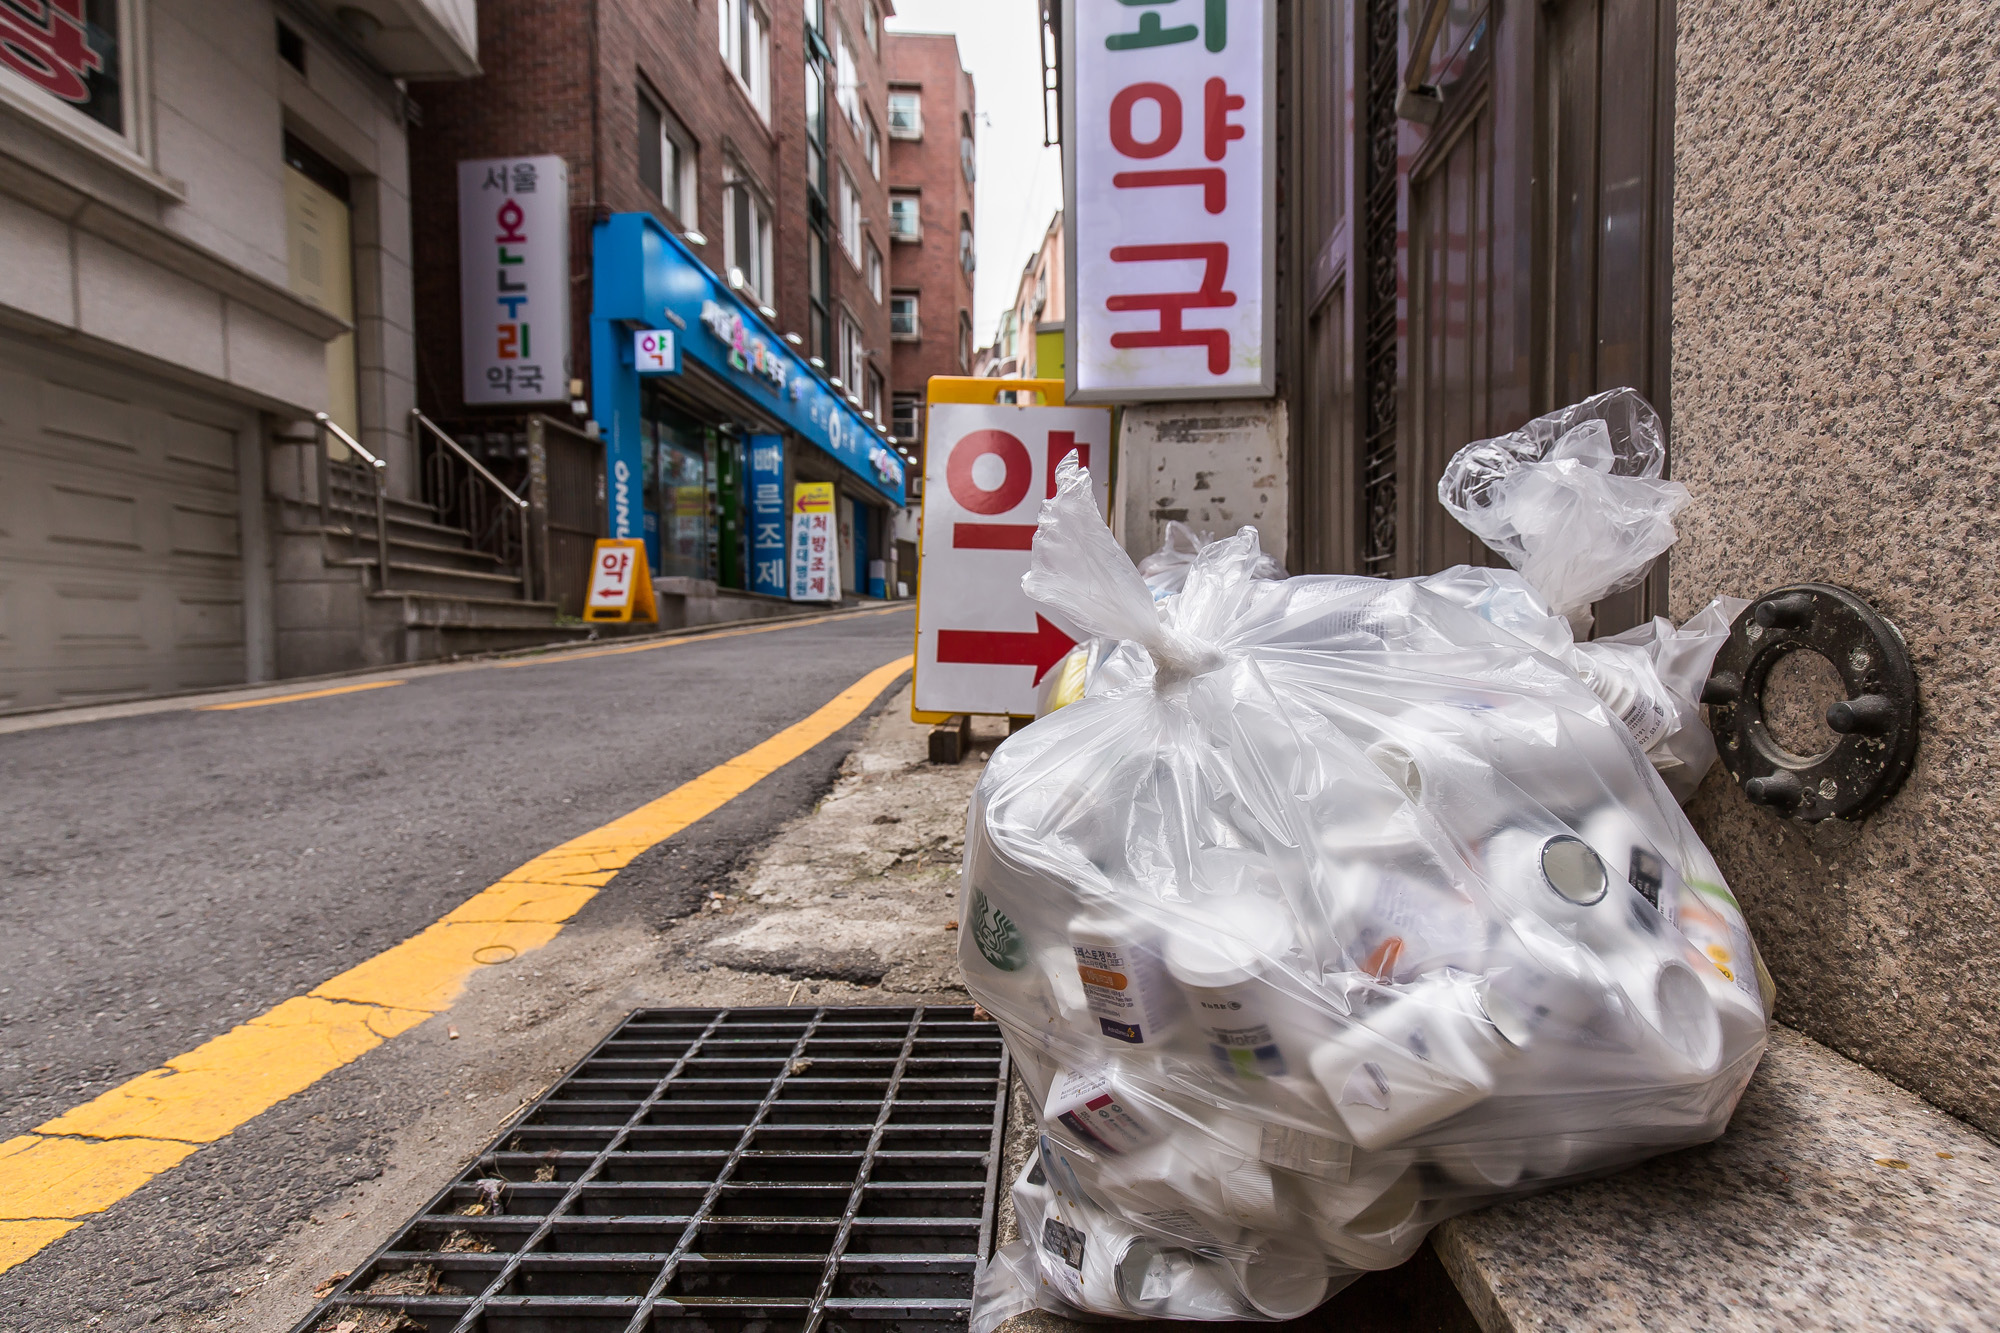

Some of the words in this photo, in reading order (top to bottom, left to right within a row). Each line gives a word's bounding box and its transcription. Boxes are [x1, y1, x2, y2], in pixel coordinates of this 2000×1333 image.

[482, 163, 538, 194] 서울
[495, 198, 531, 360] 온누리
[486, 365, 544, 394] 약국
[642, 336, 667, 366] 약
[753, 444, 785, 588] 빠른조제
[946, 428, 1091, 551] 약
[602, 552, 629, 583] 약
[795, 516, 810, 596] 서울대병원
[810, 515, 827, 594] 처방조제
